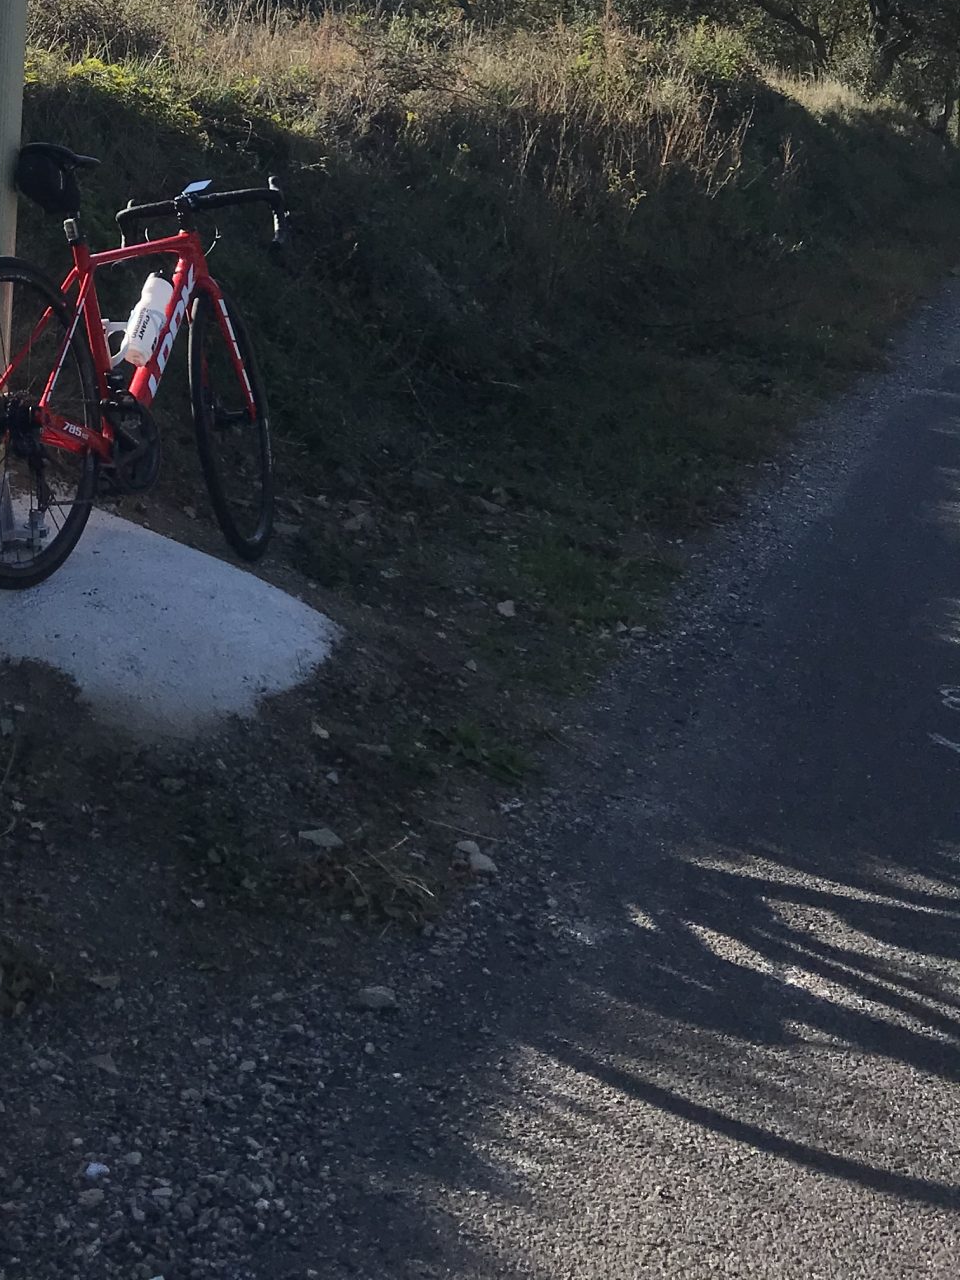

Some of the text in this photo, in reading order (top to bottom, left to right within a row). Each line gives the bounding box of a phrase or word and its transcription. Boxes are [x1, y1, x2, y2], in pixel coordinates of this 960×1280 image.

[139, 315, 150, 340] GIANT
[148, 263, 196, 399] LOOK
[62, 421, 82, 437] 785
